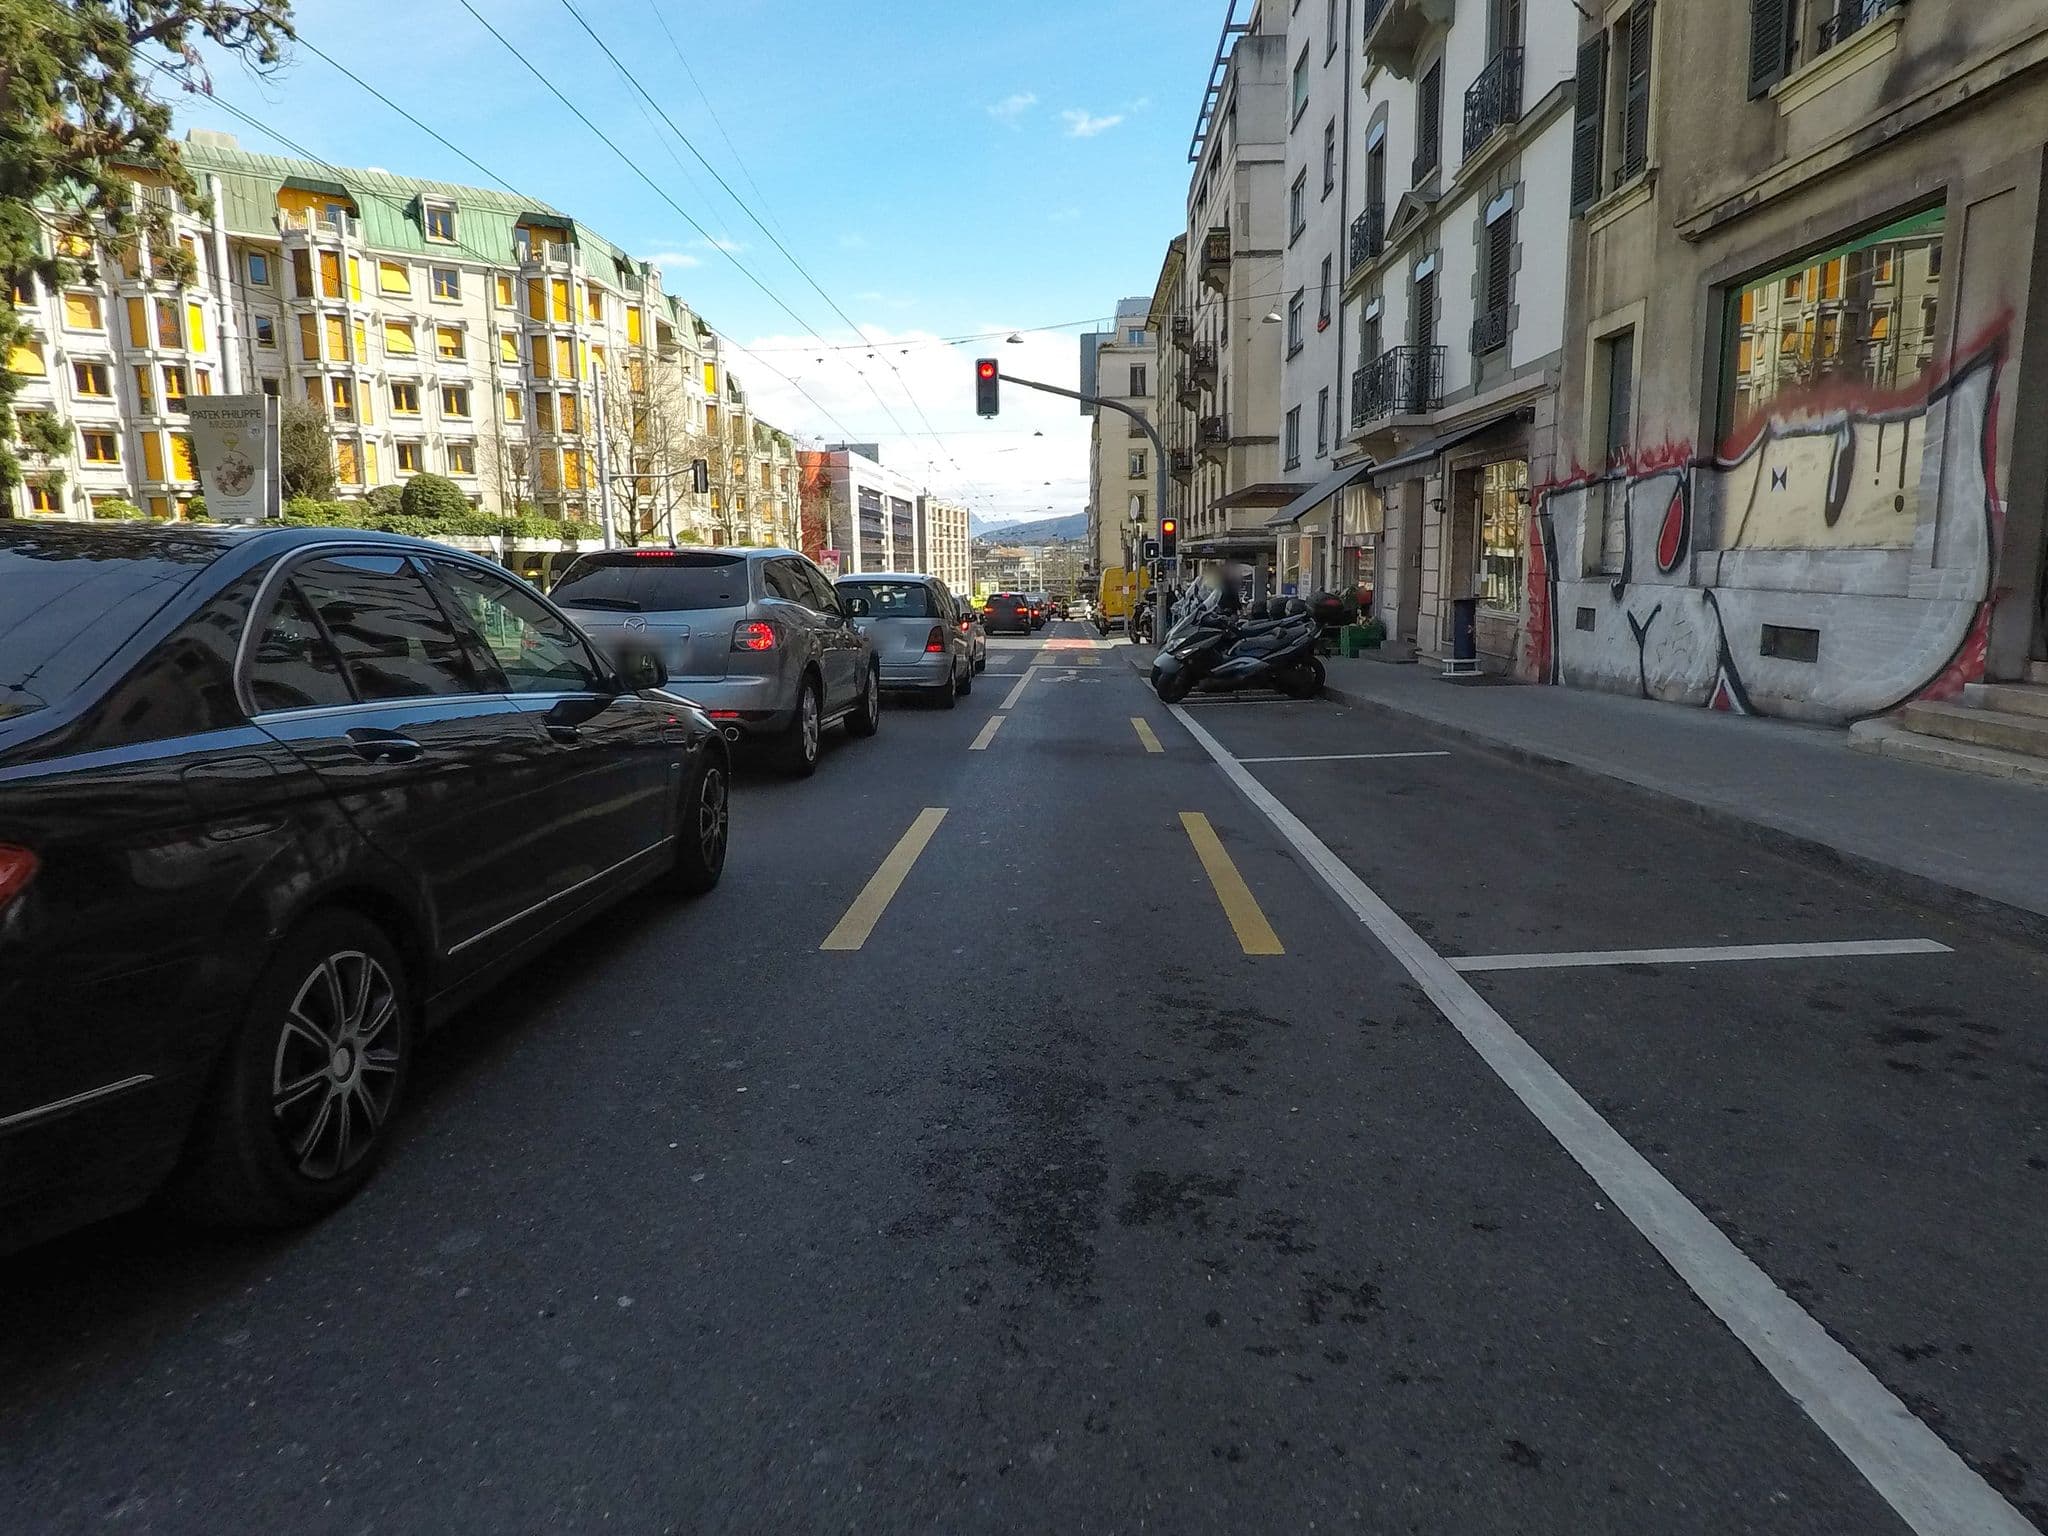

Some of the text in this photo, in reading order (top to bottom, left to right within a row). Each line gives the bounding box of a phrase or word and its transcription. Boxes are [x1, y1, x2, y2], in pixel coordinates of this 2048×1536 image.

[191, 409, 262, 419] PATEK PHILIPPE
[208, 420, 249, 429] MUSEUM
